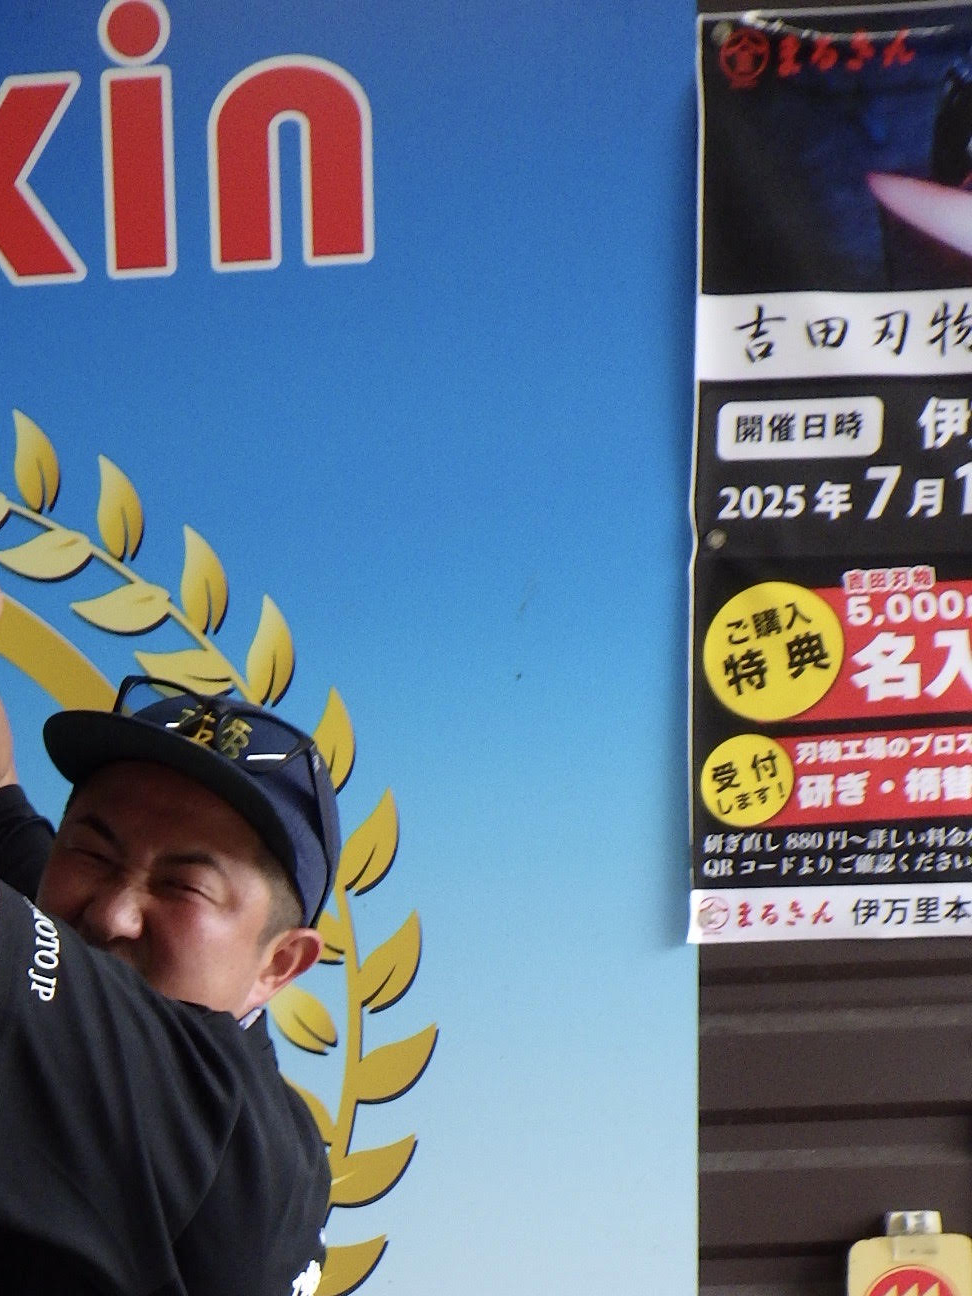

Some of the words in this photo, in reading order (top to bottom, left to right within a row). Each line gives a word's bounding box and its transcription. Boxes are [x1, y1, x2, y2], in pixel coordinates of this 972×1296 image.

[733, 303, 972, 363] 吉田刃物
[734, 410, 864, 443] 開催日時
[917, 396, 972, 450] 伊
[726, 602, 812, 645] ご購入
[846, 590, 972, 627] 5,000
[711, 749, 780, 794] 受付
[737, 899, 834, 929] まるきん
[851, 895, 972, 926] 伊万里本
